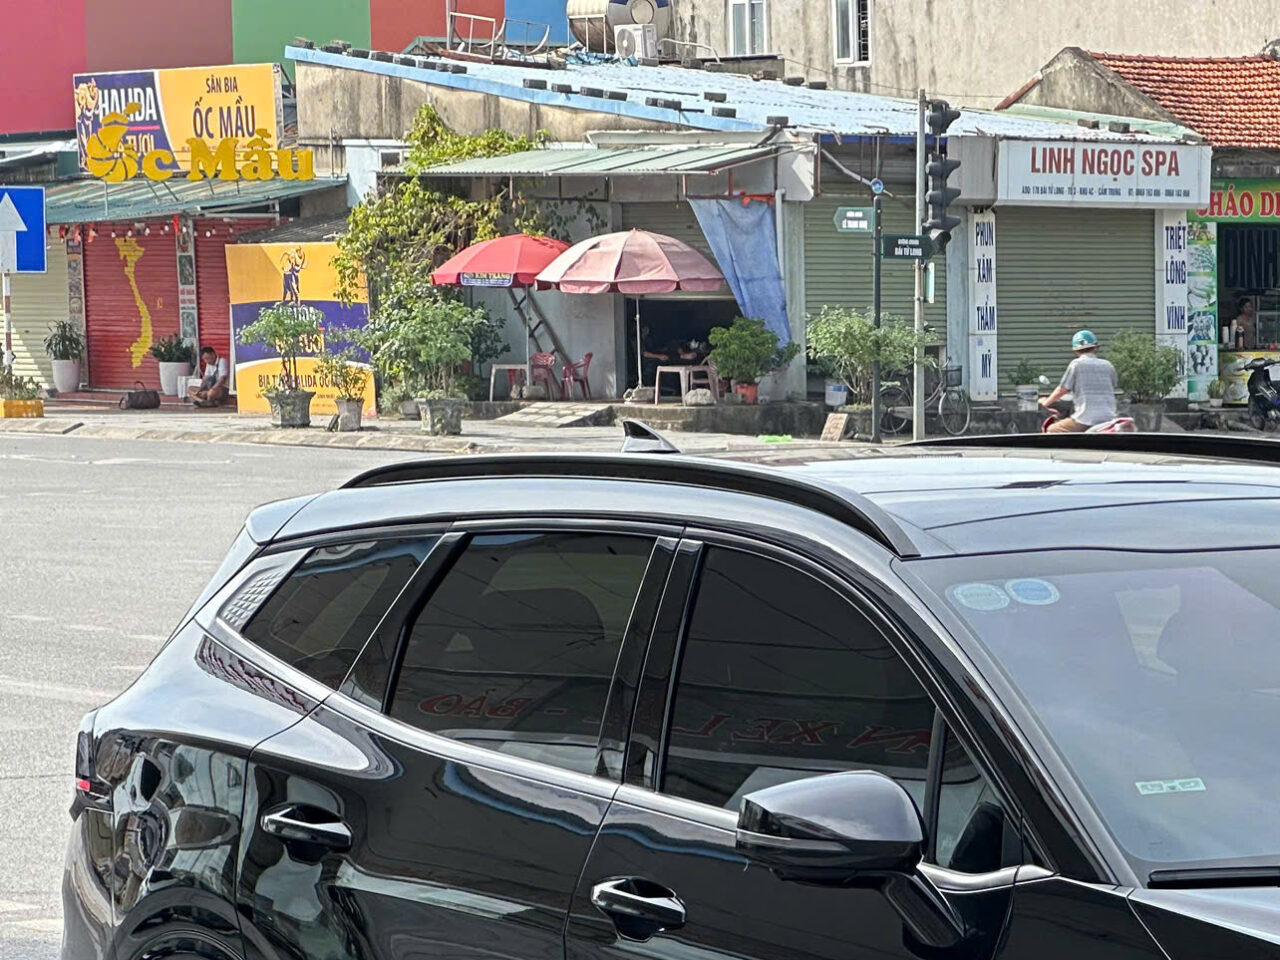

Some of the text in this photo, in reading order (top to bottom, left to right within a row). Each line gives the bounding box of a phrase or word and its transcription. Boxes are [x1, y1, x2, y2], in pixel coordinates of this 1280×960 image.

[224, 77, 238, 92] BIA
[193, 95, 255, 139] ỐC MẦU
[186, 128, 316, 181] Mầu
[1031, 147, 1180, 182] LINH NGỌC SPA
[975, 221, 993, 247] PHUN
[1165, 221, 1186, 253] TRIỆT
